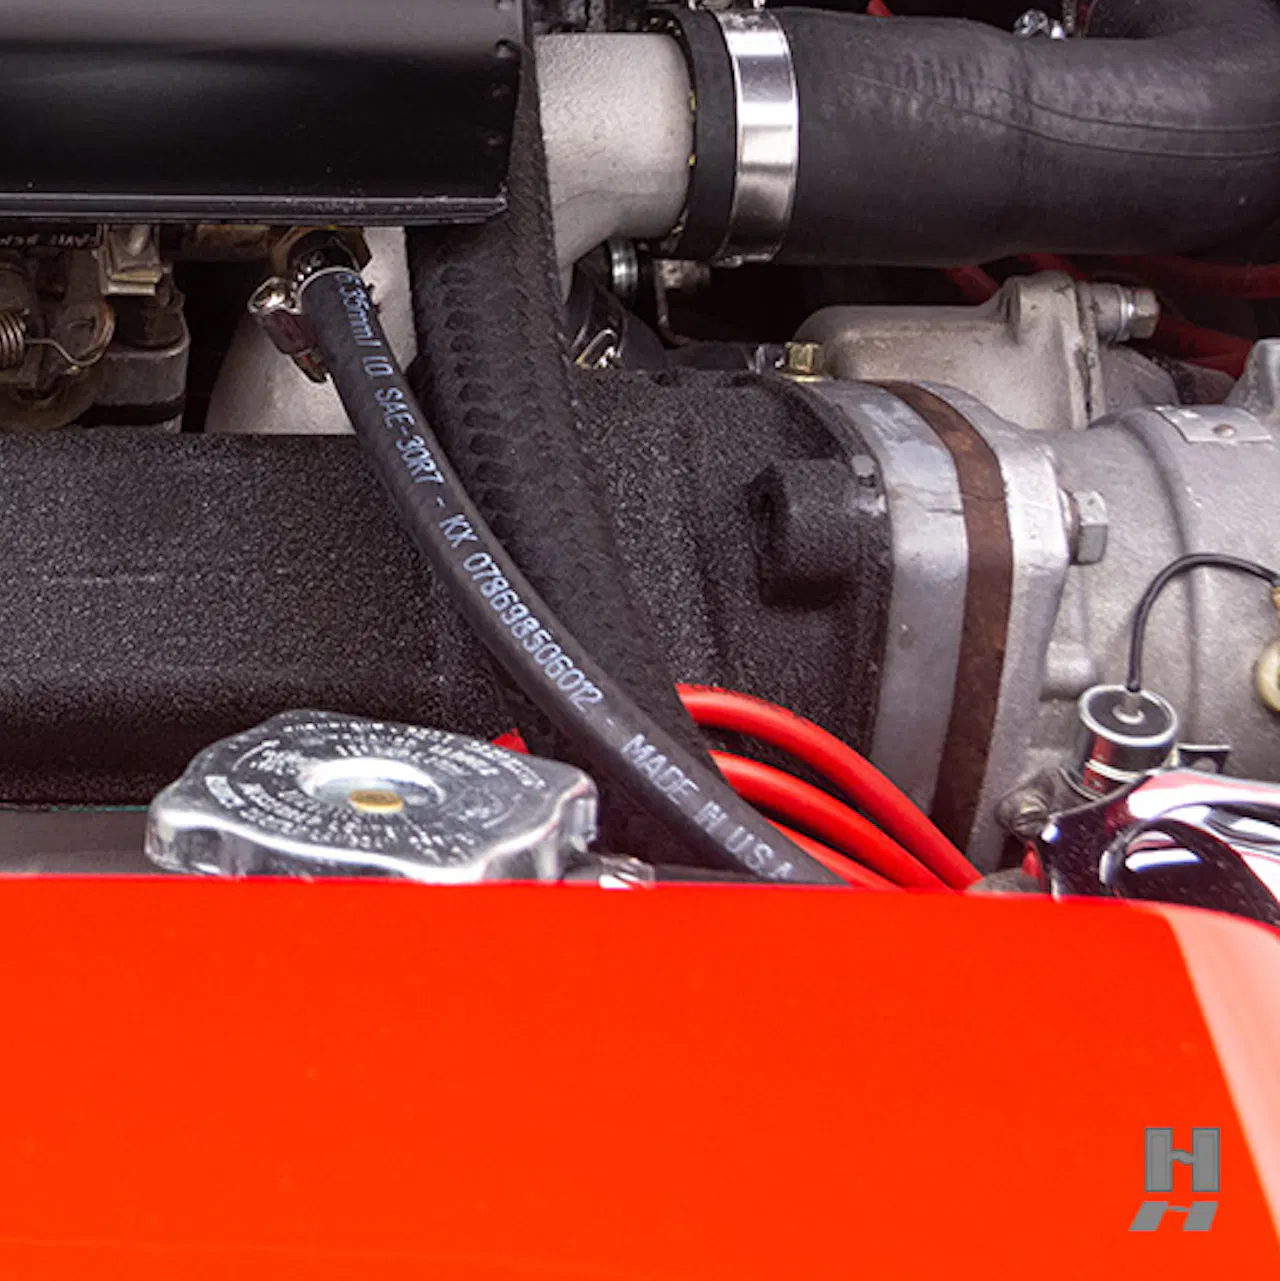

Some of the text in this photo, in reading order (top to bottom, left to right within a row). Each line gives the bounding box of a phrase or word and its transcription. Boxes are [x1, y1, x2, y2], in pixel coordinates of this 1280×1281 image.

[374, 386, 445, 485] SAE-30R7
[439, 514, 480, 549] KX
[462, 552, 604, 713] 078698506012
[620, 733, 700, 806] MADE
[693, 800, 729, 833] IN
